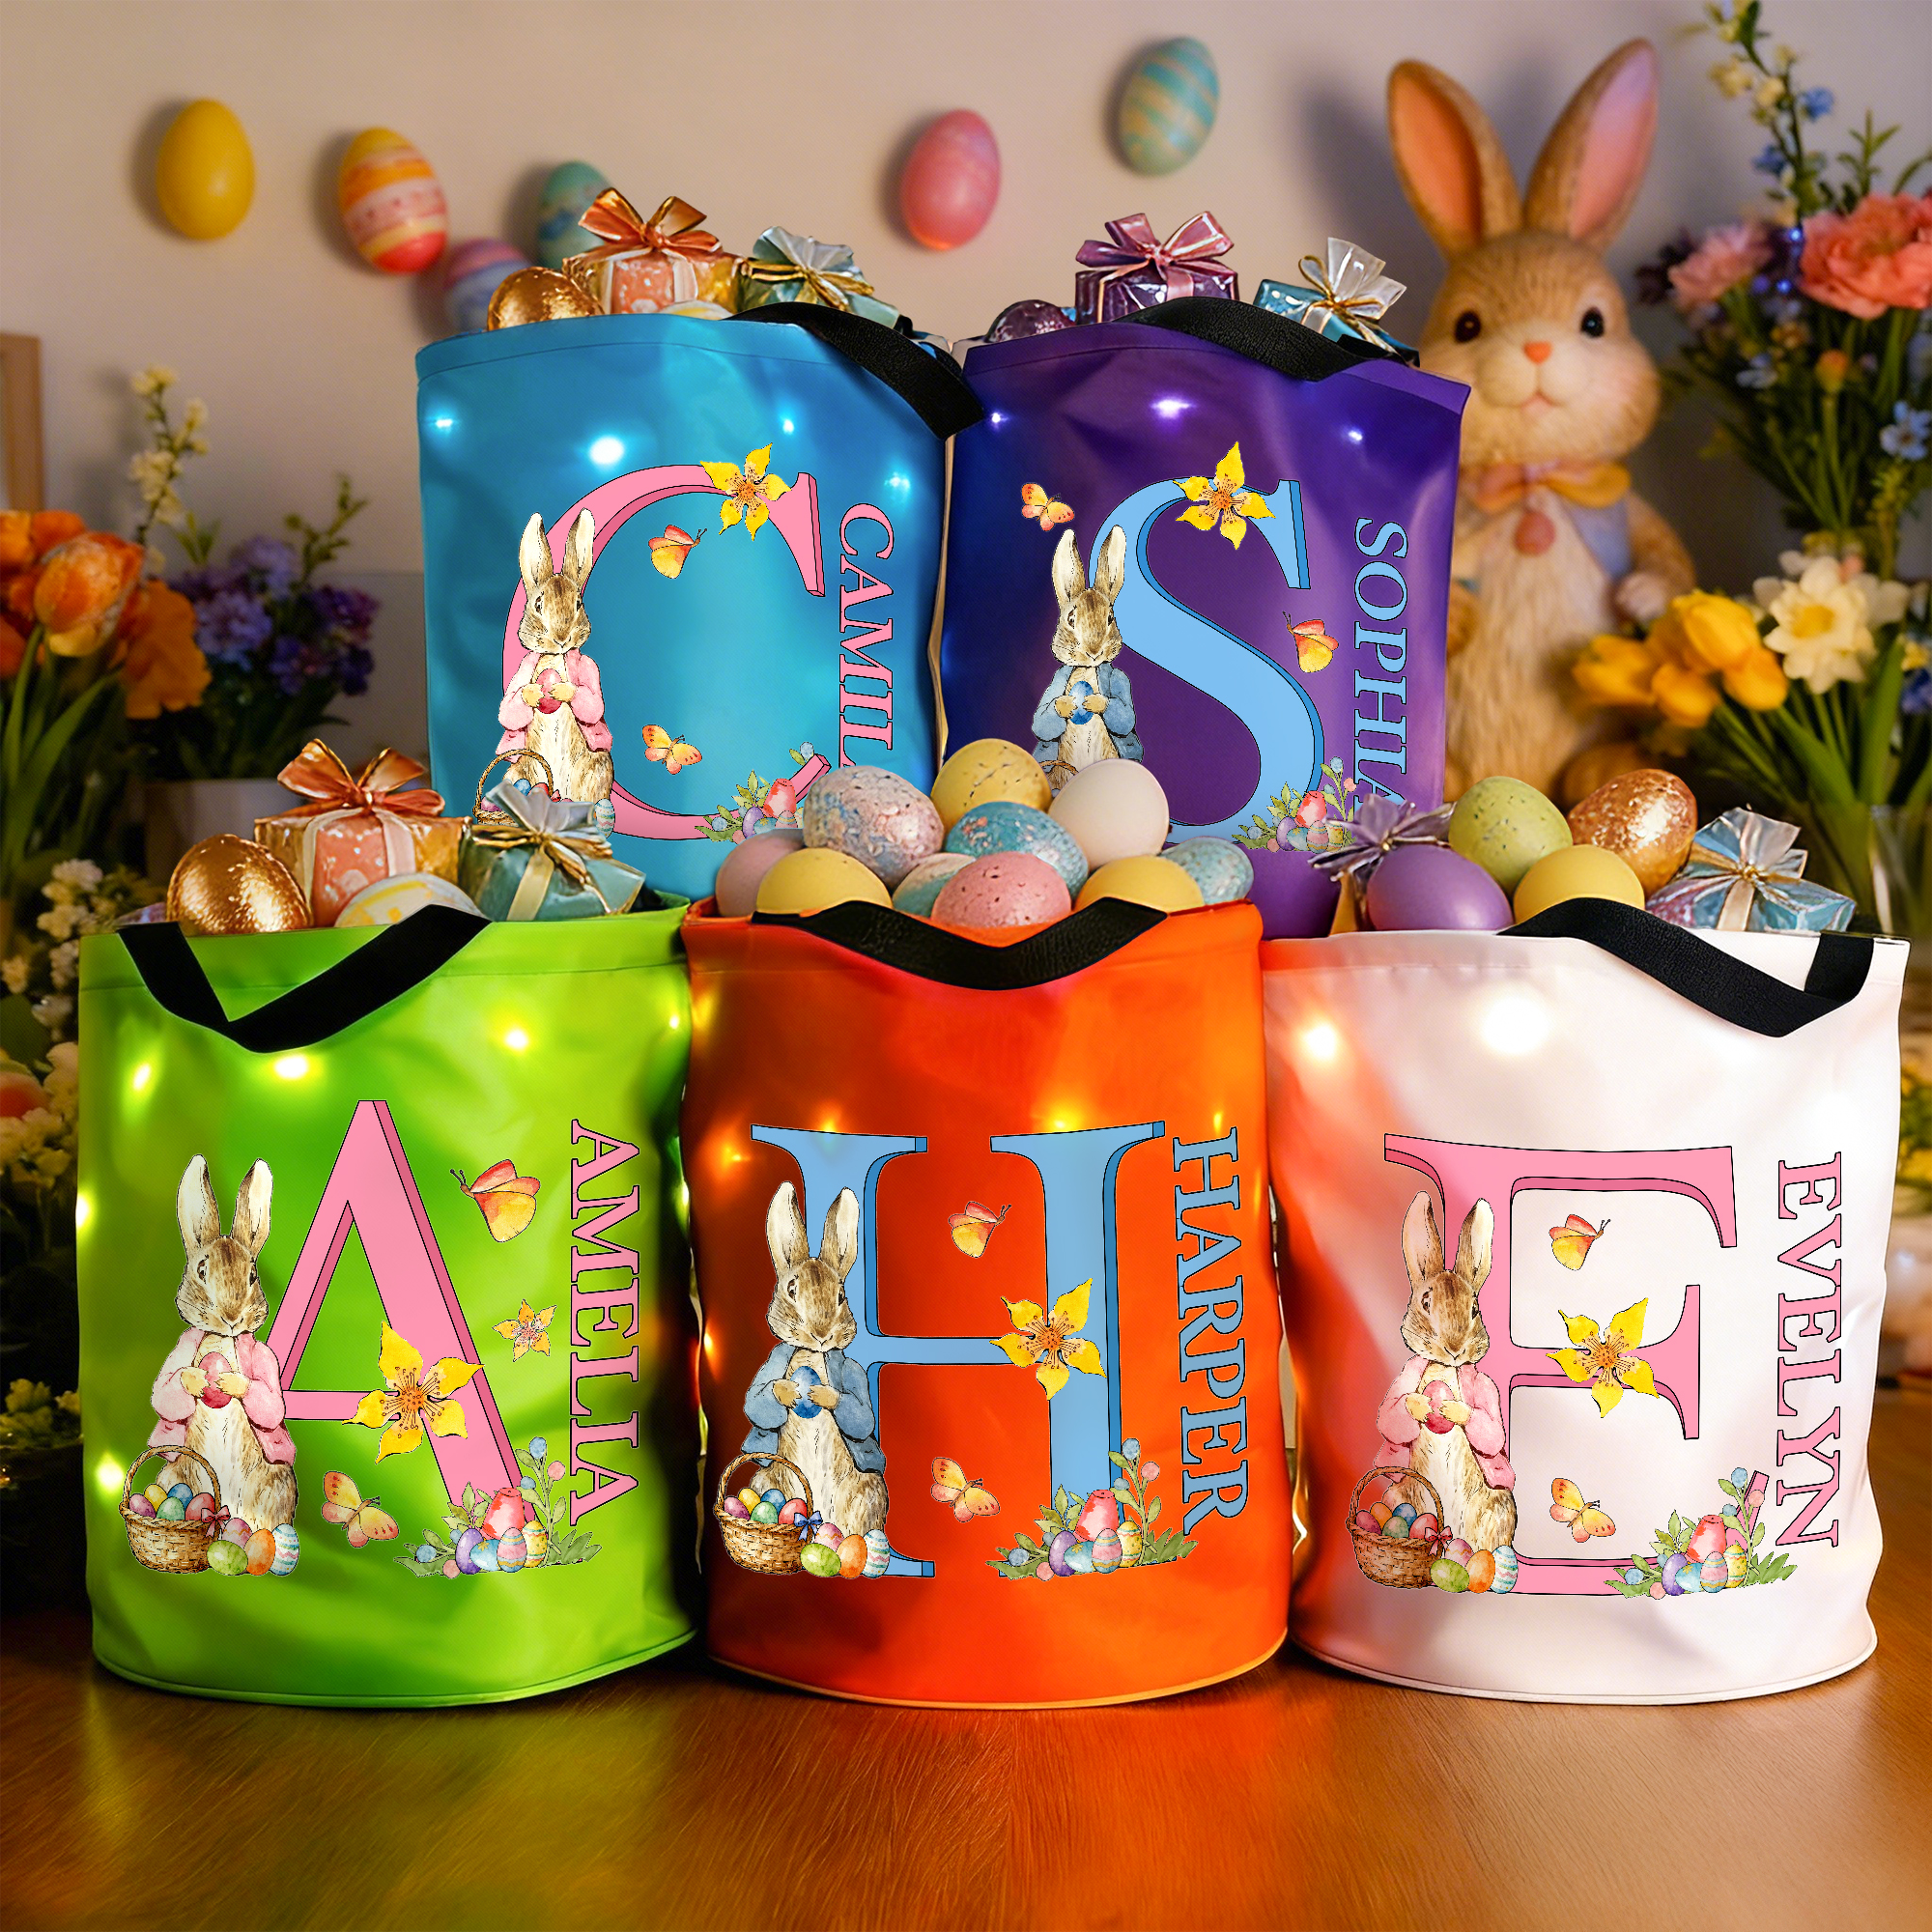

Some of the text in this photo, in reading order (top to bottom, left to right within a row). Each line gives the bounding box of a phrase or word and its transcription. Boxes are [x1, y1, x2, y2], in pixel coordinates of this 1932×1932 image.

[502, 465, 832, 840] C
[839, 502, 895, 768] CAMIL
[1089, 476, 1324, 844] S
[261, 1099, 580, 1561] A
[570, 1119, 640, 1526] AMELIA
[751, 1120, 1165, 1577] H
[1172, 1126, 1249, 1535] HARPER
[1383, 1133, 1770, 1596] E
[1775, 1151, 1843, 1548] EVELYN
